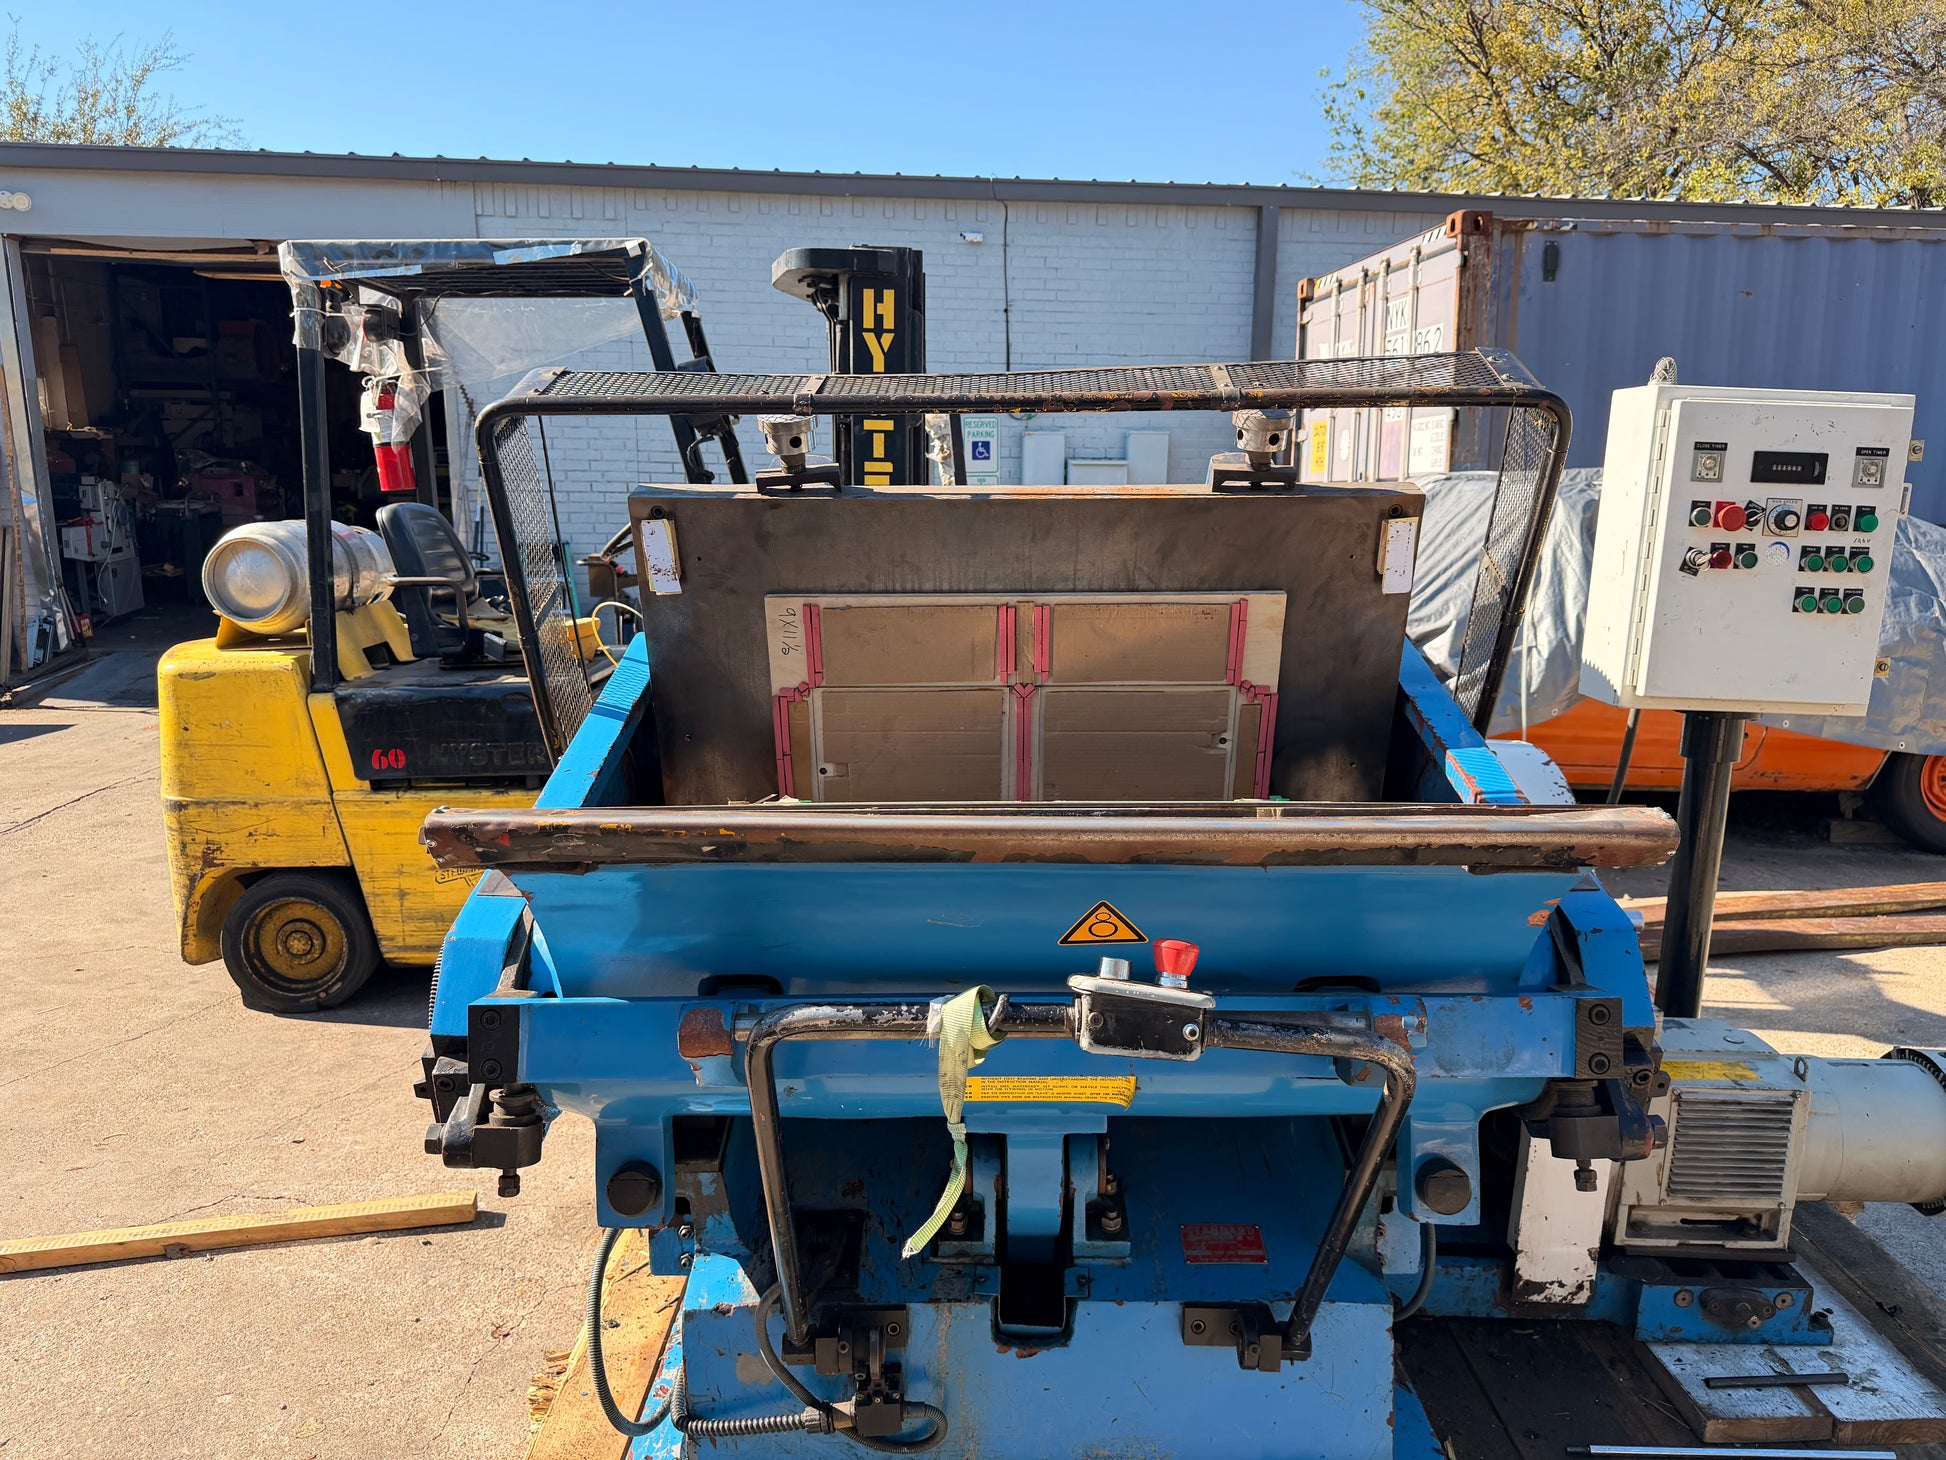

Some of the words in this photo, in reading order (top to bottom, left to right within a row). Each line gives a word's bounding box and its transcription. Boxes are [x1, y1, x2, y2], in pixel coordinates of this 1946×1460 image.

[964, 420, 997, 428] RESERVED
[967, 430, 995, 439] PARKING
[371, 748, 406, 770] 60
